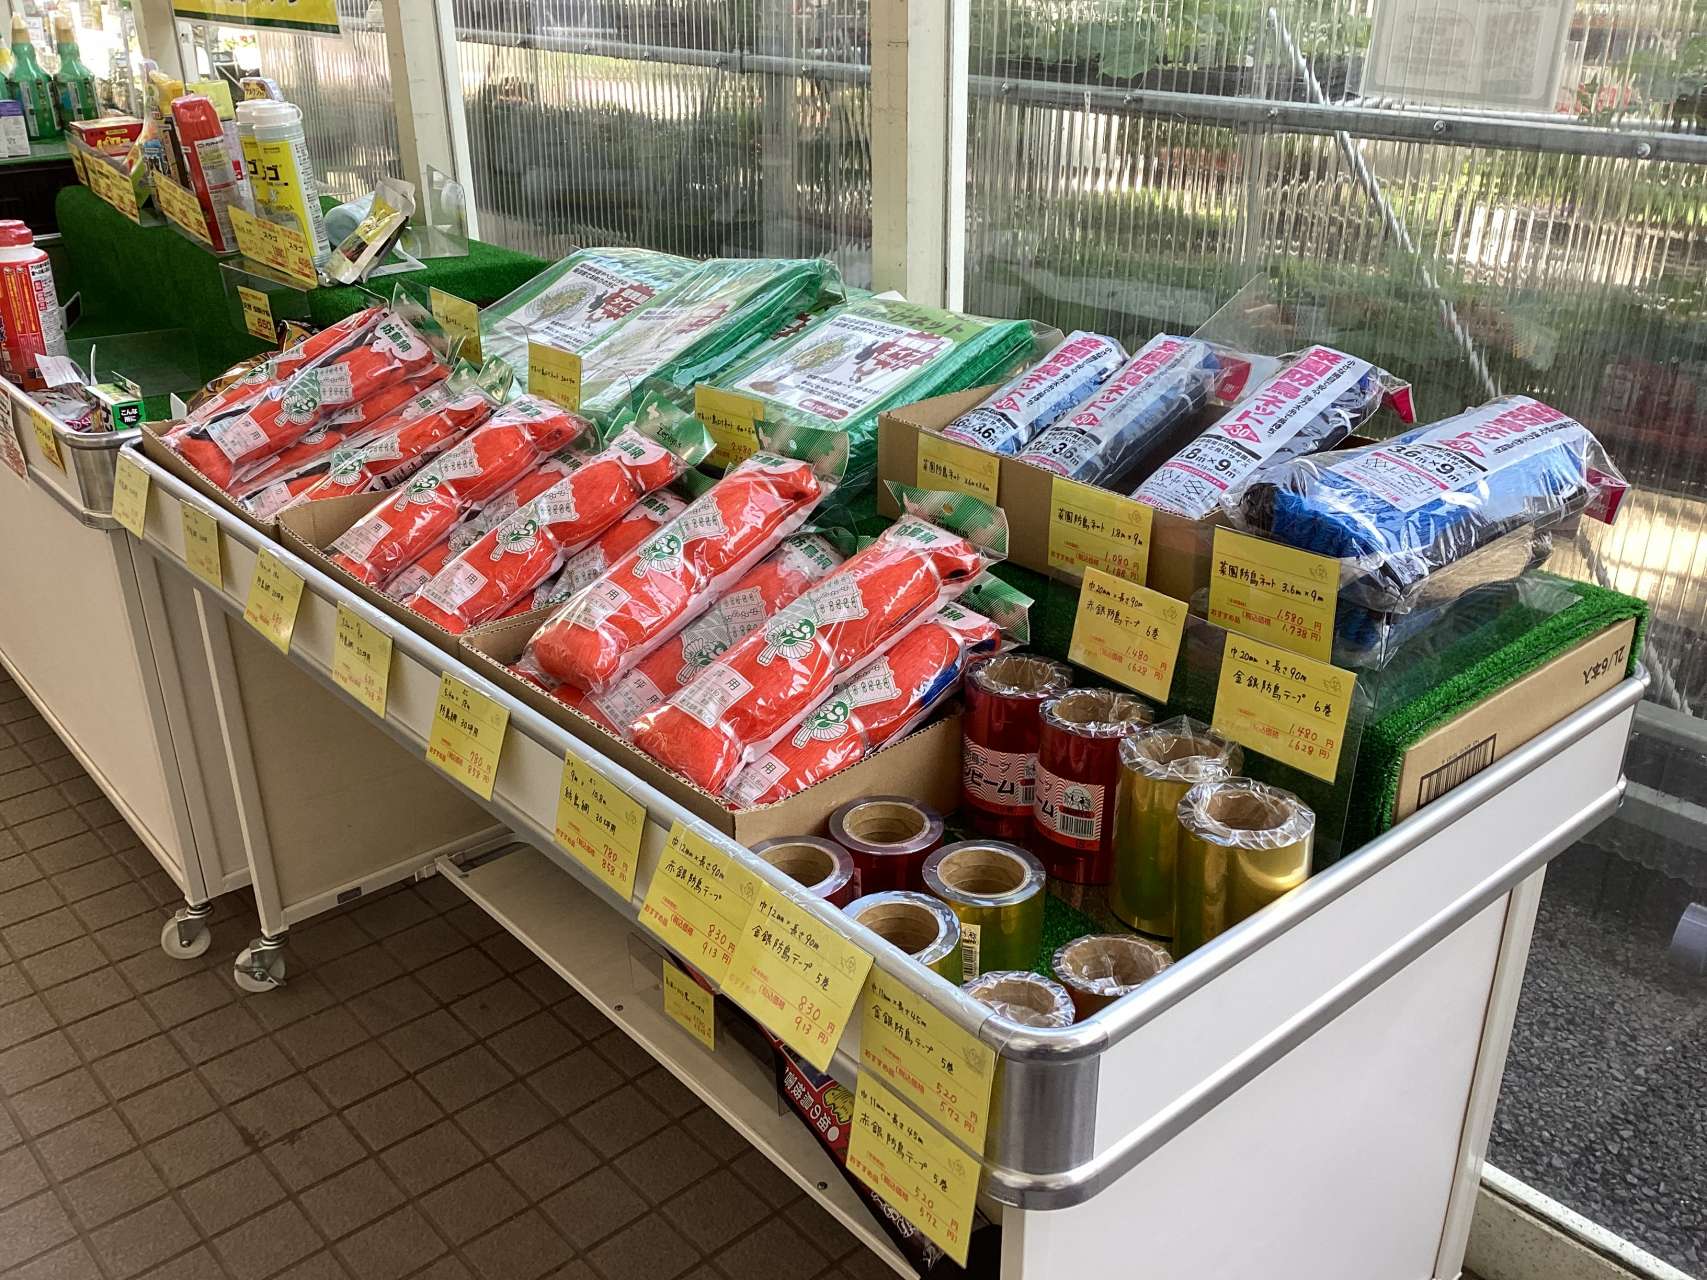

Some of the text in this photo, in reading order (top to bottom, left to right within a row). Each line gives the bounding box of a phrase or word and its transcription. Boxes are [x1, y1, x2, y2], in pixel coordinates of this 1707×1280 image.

[381, 324, 413, 353] 防鳥網
[1012, 336, 1106, 399] 菜園防鳥ネット
[1235, 348, 1345, 426] 菜園防鳥ネット
[1057, 507, 1105, 533] 菜園防鳥ネット
[893, 523, 940, 546] 防鳥網
[791, 535, 833, 571] 防鳥網
[1218, 561, 1276, 588] 菜園防鳥ネット
[1232, 670, 1333, 718] 金銀防鳥テープ 6巻
[707, 924, 727, 945] 830
[752, 924, 830, 992] 金銀防鳥テープ 5巻
[799, 995, 821, 1020] 830
[794, 1016, 812, 1036] 913
[872, 1004, 934, 1054] 金銀防鳥テープ
[936, 1081, 958, 1103] 520
[939, 1101, 960, 1122] 572
[932, 1173, 949, 1193] 5巻
[914, 1186, 935, 1209] 520
[919, 1206, 938, 1227] 572
